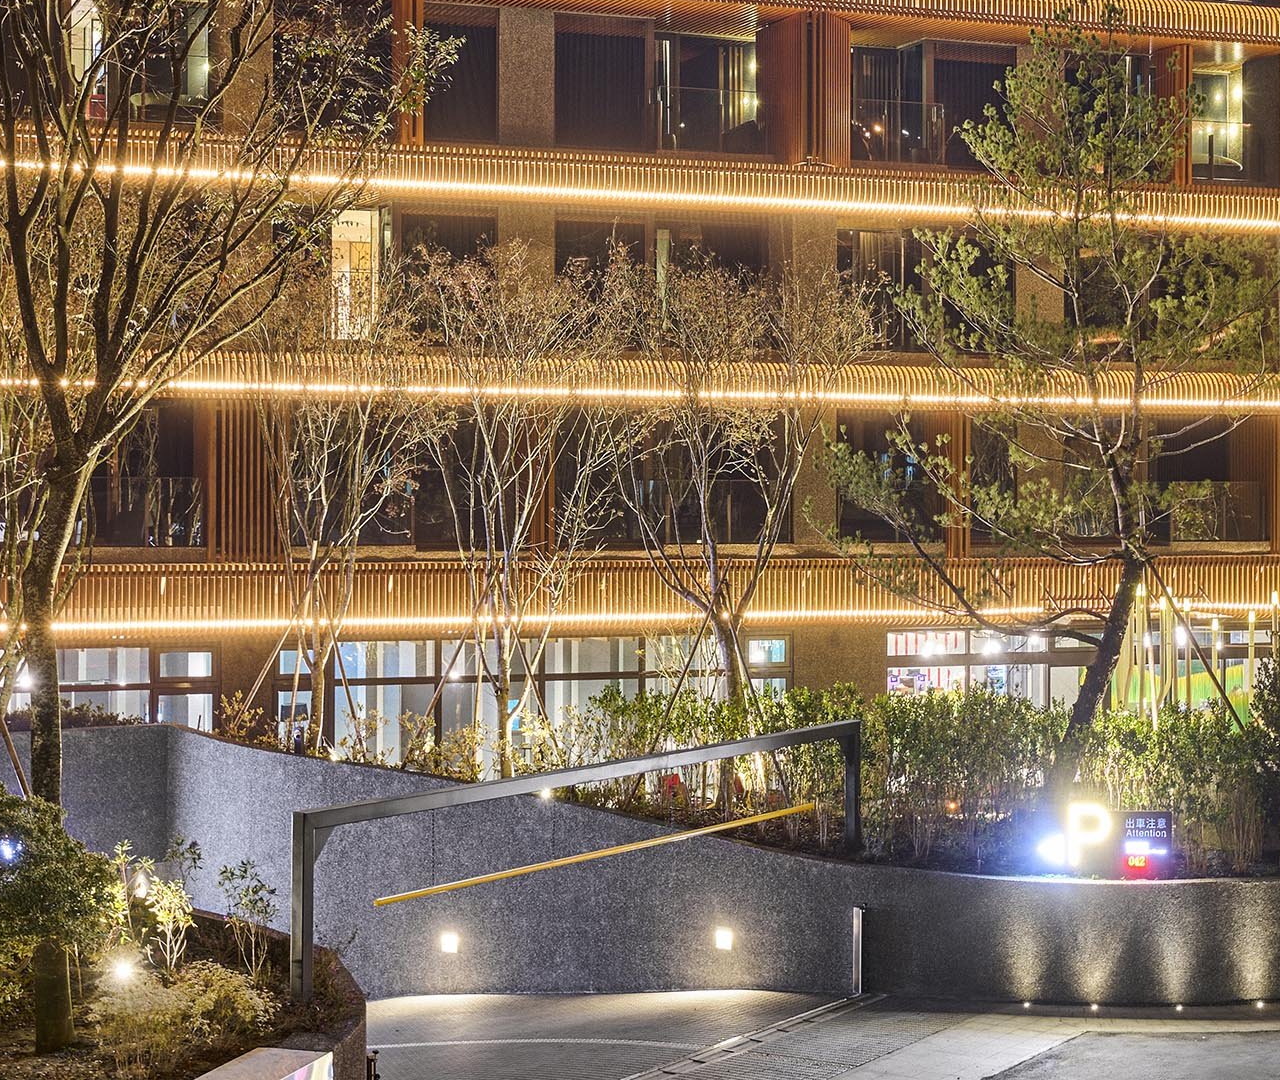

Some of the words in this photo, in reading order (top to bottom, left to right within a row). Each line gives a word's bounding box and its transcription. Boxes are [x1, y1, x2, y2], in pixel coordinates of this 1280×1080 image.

[1125, 817, 1167, 829] 出車注意
[1067, 802, 1112, 867] P
[1126, 829, 1167, 838] Attention
